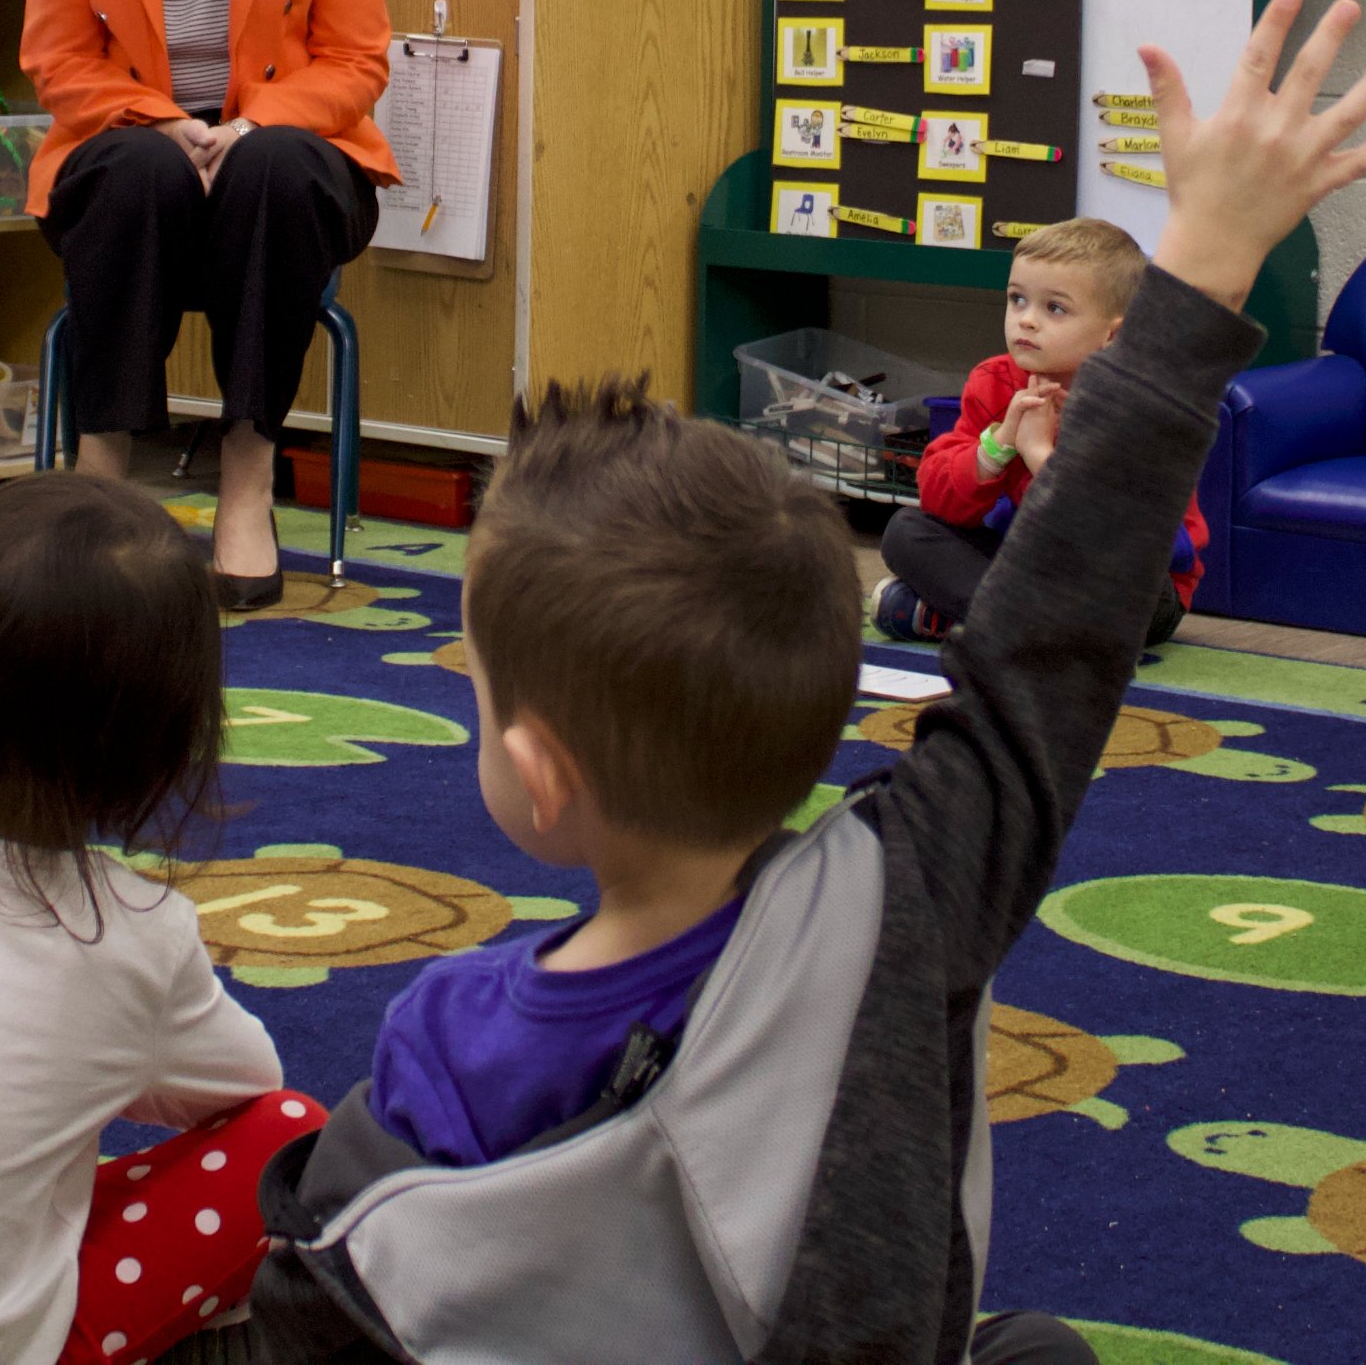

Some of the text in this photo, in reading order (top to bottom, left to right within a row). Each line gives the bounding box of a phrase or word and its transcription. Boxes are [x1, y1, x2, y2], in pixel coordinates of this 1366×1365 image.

[858, 47, 901, 60] Jackson
[805, 69, 826, 78] Helper
[936, 75, 977, 84] Water Helper
[863, 110, 896, 125] Carter
[857, 125, 889, 140] Evelyn
[994, 142, 1020, 155] Liam
[847, 209, 879, 225] Amelia
[193, 883, 389, 938] 13
[1207, 902, 1315, 945] 9
